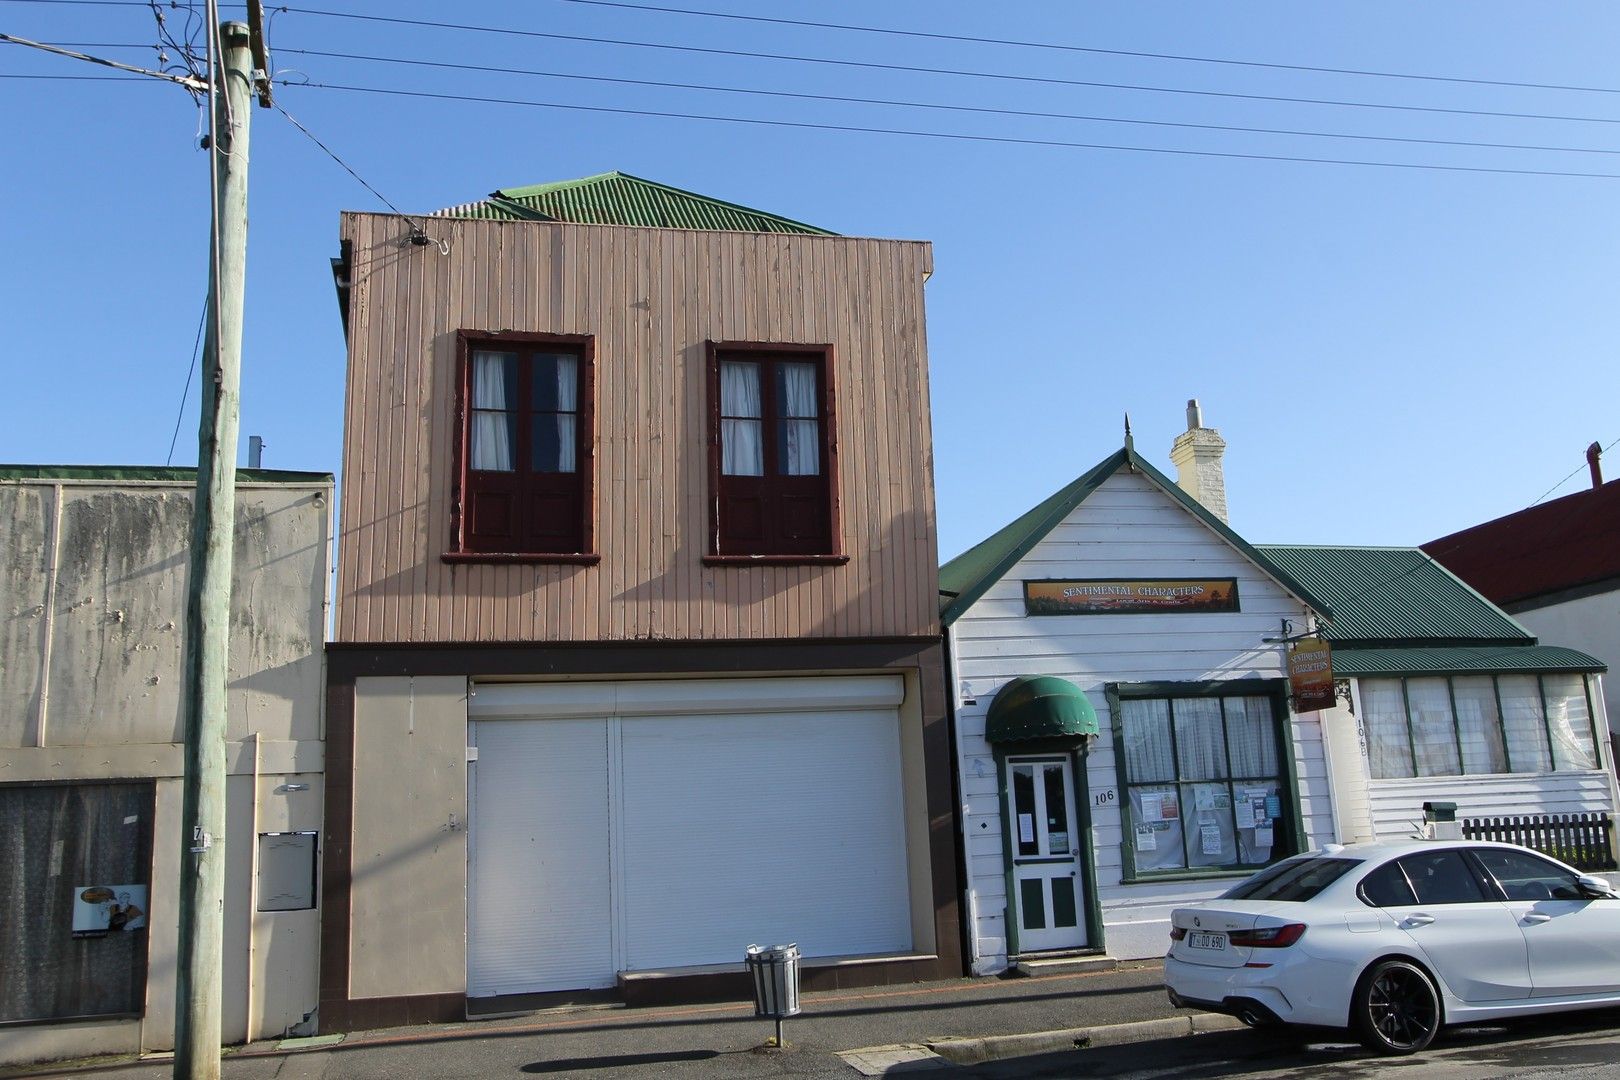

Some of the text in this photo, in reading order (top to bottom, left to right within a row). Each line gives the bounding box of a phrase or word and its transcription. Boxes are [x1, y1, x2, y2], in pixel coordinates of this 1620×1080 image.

[1063, 585, 1204, 598] SENTIMENTAL CHARACTERS
[1095, 790, 1114, 806] 106
[195, 827, 202, 839] 7
